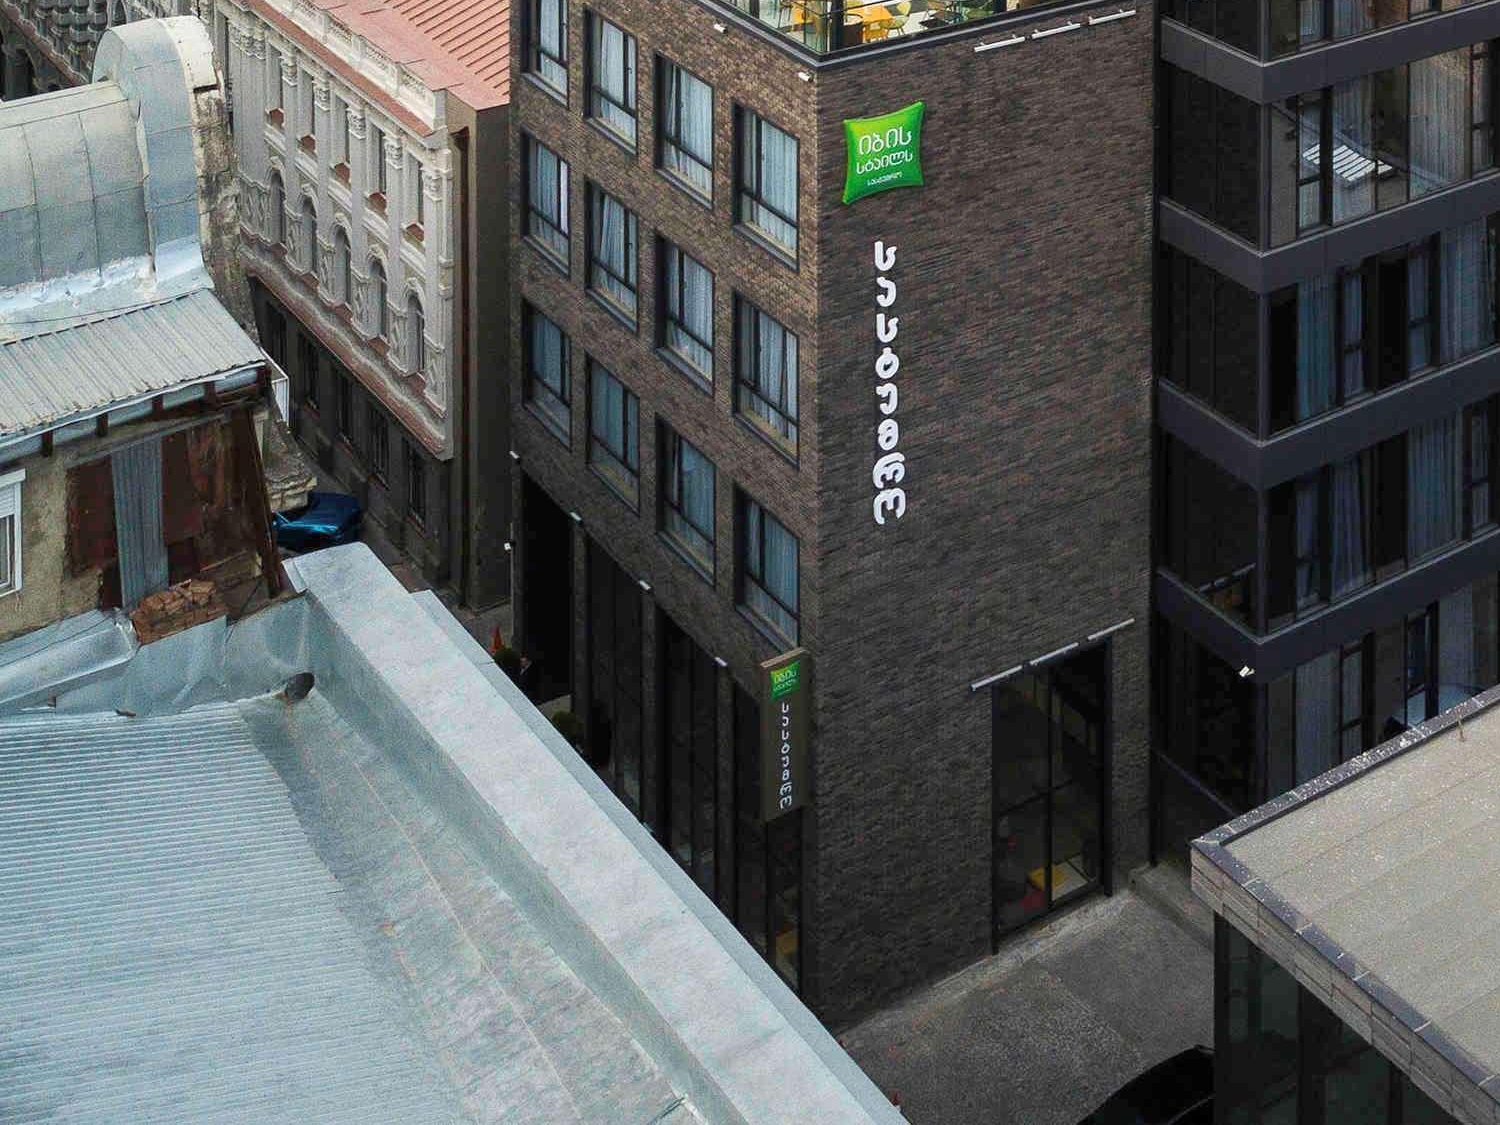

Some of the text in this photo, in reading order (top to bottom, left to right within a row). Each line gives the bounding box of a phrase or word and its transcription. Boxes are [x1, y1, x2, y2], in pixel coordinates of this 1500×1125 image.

[856, 150, 913, 174] სტაილს
[858, 126, 912, 155] იბის
[872, 241, 906, 525] სასტუმრო
[779, 702, 792, 809] სასტუმრო
